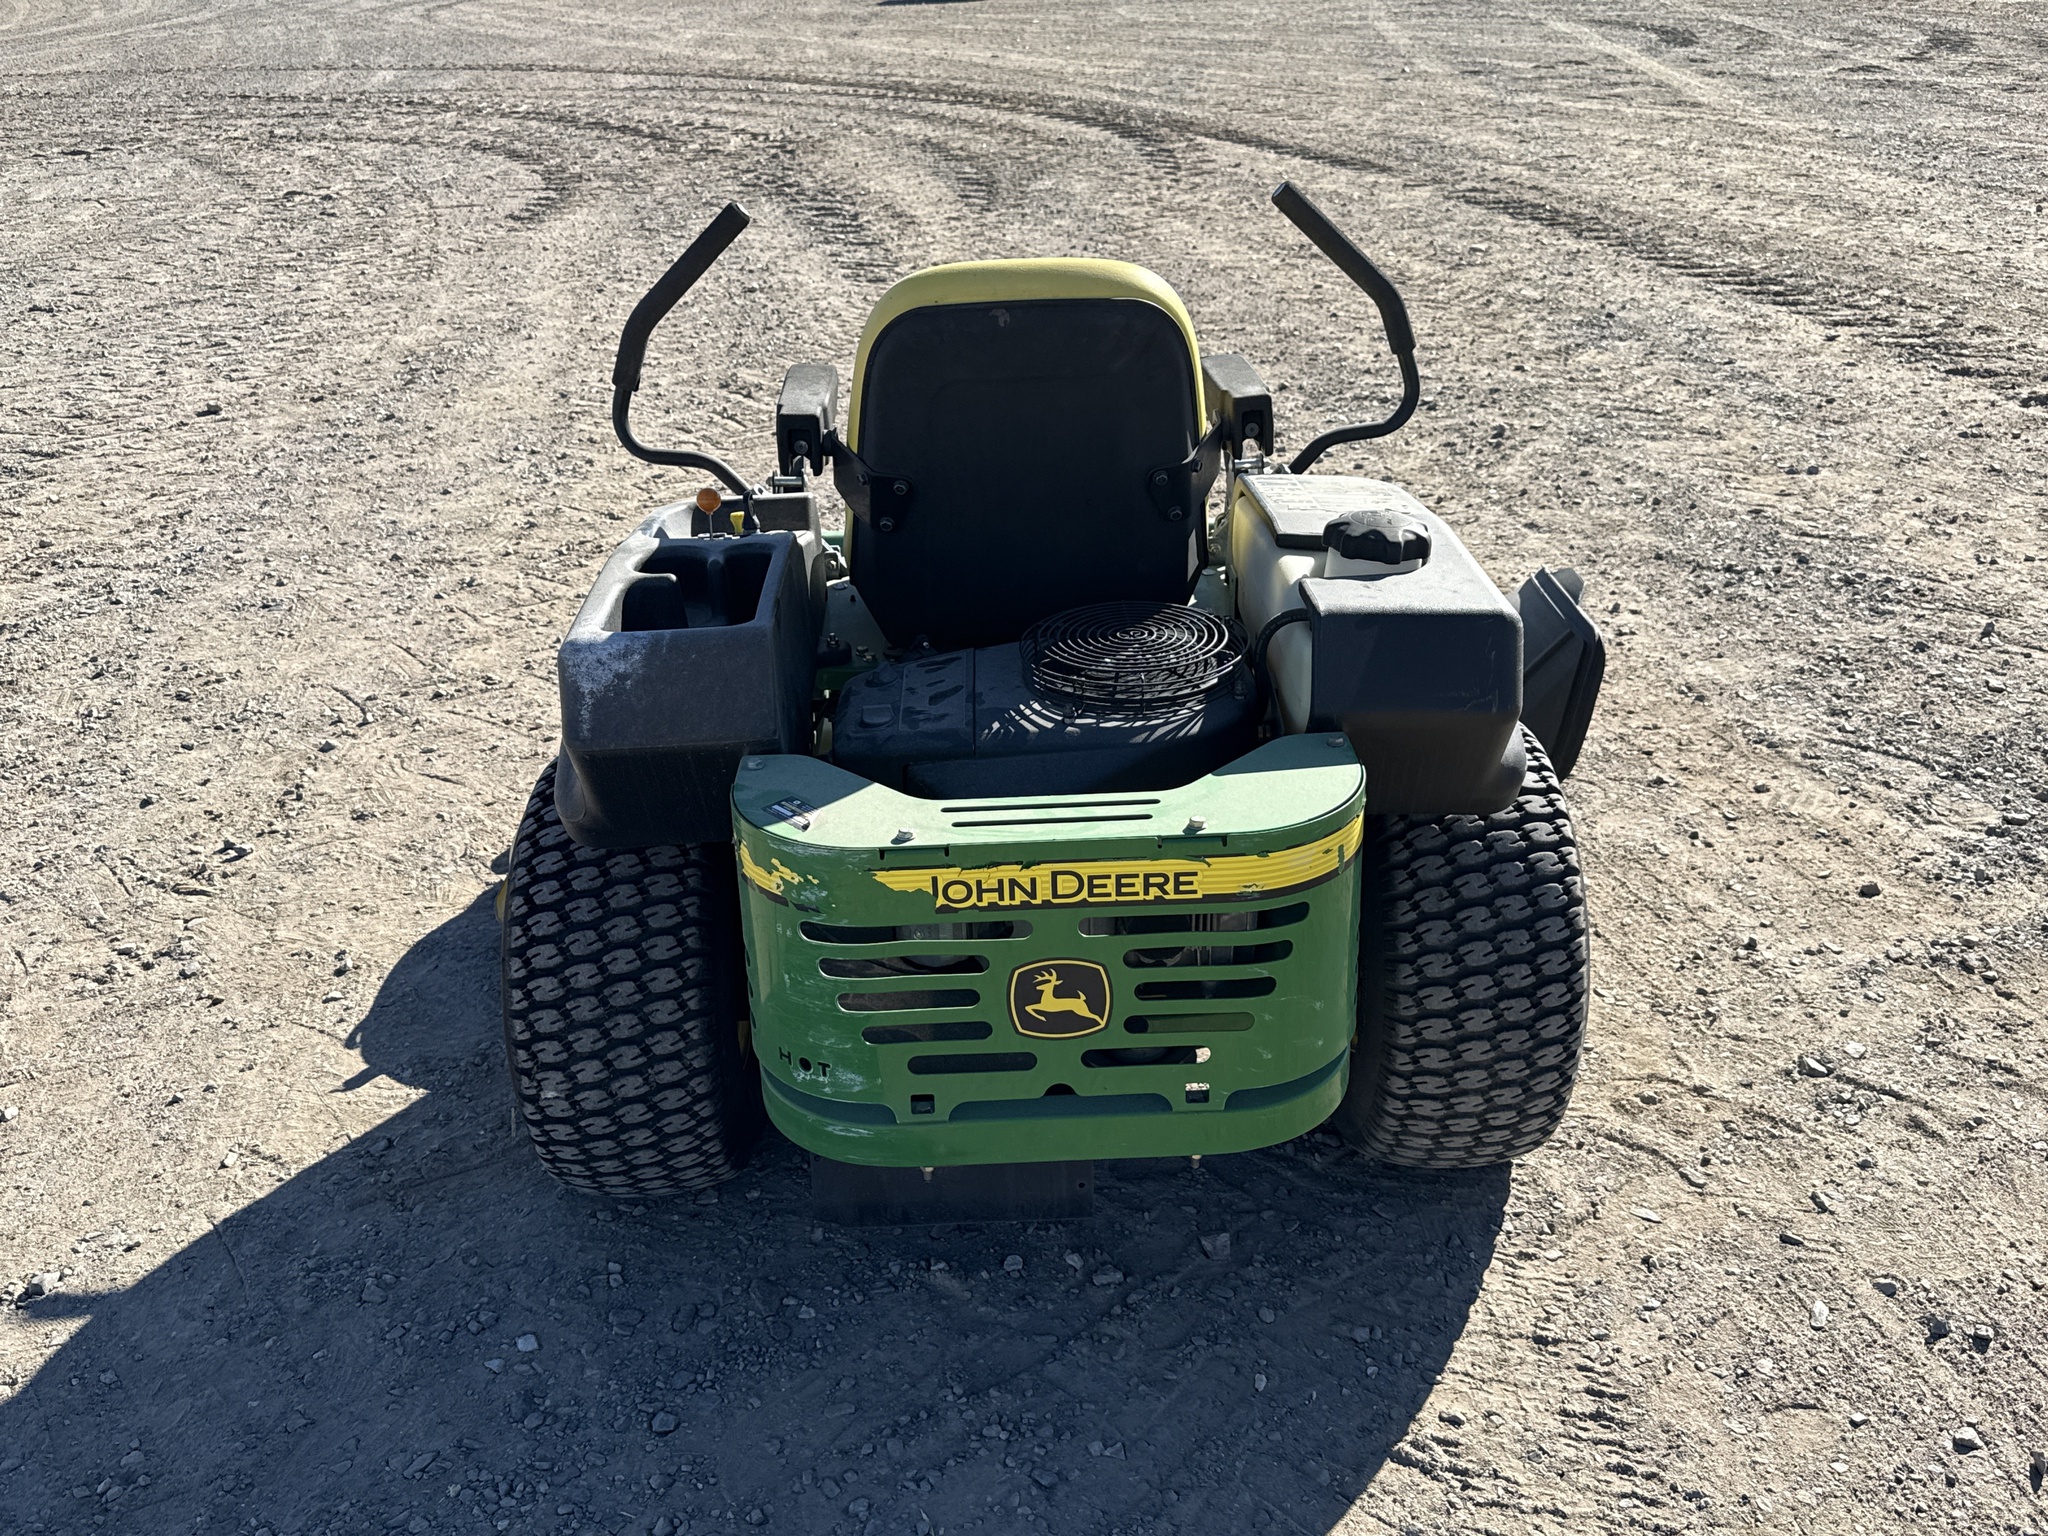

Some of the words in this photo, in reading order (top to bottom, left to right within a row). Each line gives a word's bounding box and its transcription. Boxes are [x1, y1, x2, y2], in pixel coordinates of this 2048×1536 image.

[931, 875, 1038, 904] JOHN
[1050, 870, 1199, 900] DEERE
[778, 1046, 832, 1078] HOT
